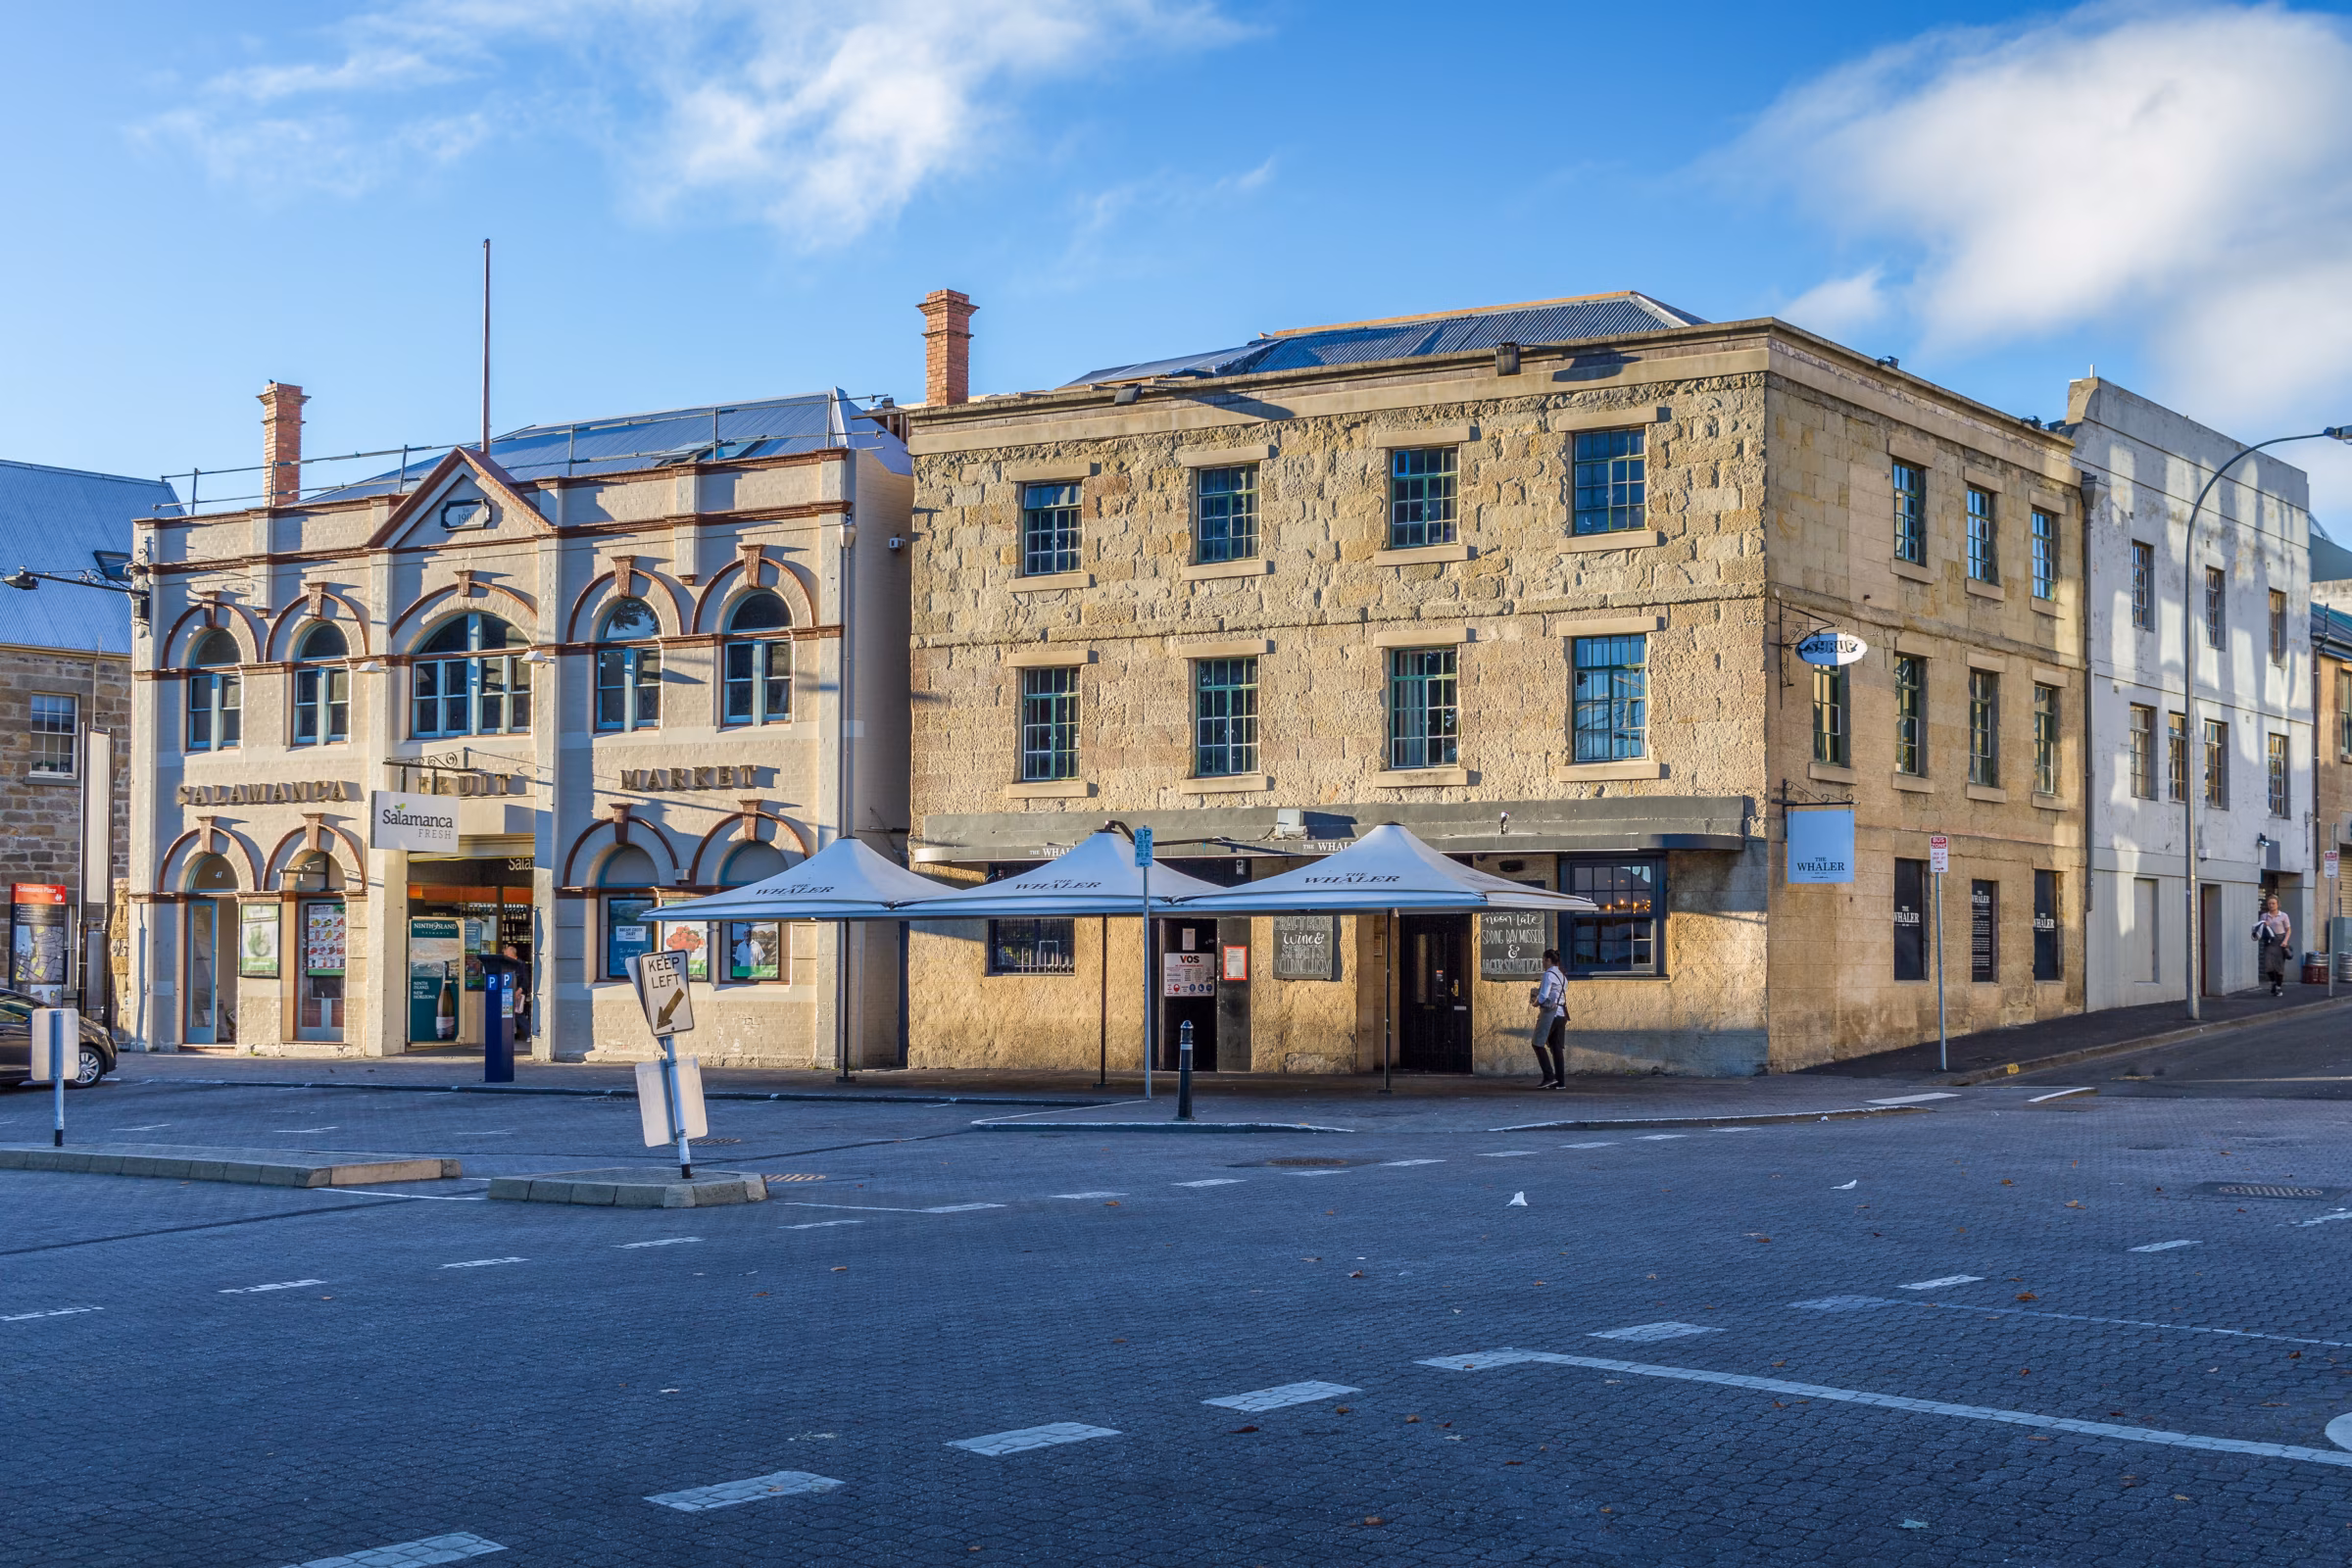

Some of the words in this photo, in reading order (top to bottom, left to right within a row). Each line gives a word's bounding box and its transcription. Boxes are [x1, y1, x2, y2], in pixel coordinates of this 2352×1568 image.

[1806, 640, 1857, 654] SYRUP
[176, 780, 348, 806] SALAMANCA
[416, 773, 511, 797] FRUIT
[619, 765, 757, 791] MARKET
[382, 808, 454, 828] Salamanca
[418, 829, 451, 840] FRESH
[1043, 848, 1071, 857] WHAL
[1317, 842, 1352, 852] WHAL
[509, 858, 535, 870] Sala
[1796, 861, 1844, 871] WHALER
[756, 886, 835, 895] WHALER
[1274, 915, 1305, 931] CRAFT
[1306, 915, 1333, 931] BEER
[1281, 944, 1325, 959] SPIRITS
[1508, 944, 1520, 958] &
[648, 956, 680, 972] KEEP
[1180, 955, 1200, 963] VOS
[489, 976, 496, 989] P
[504, 974, 510, 986] P
[652, 973, 680, 989] LEFT
